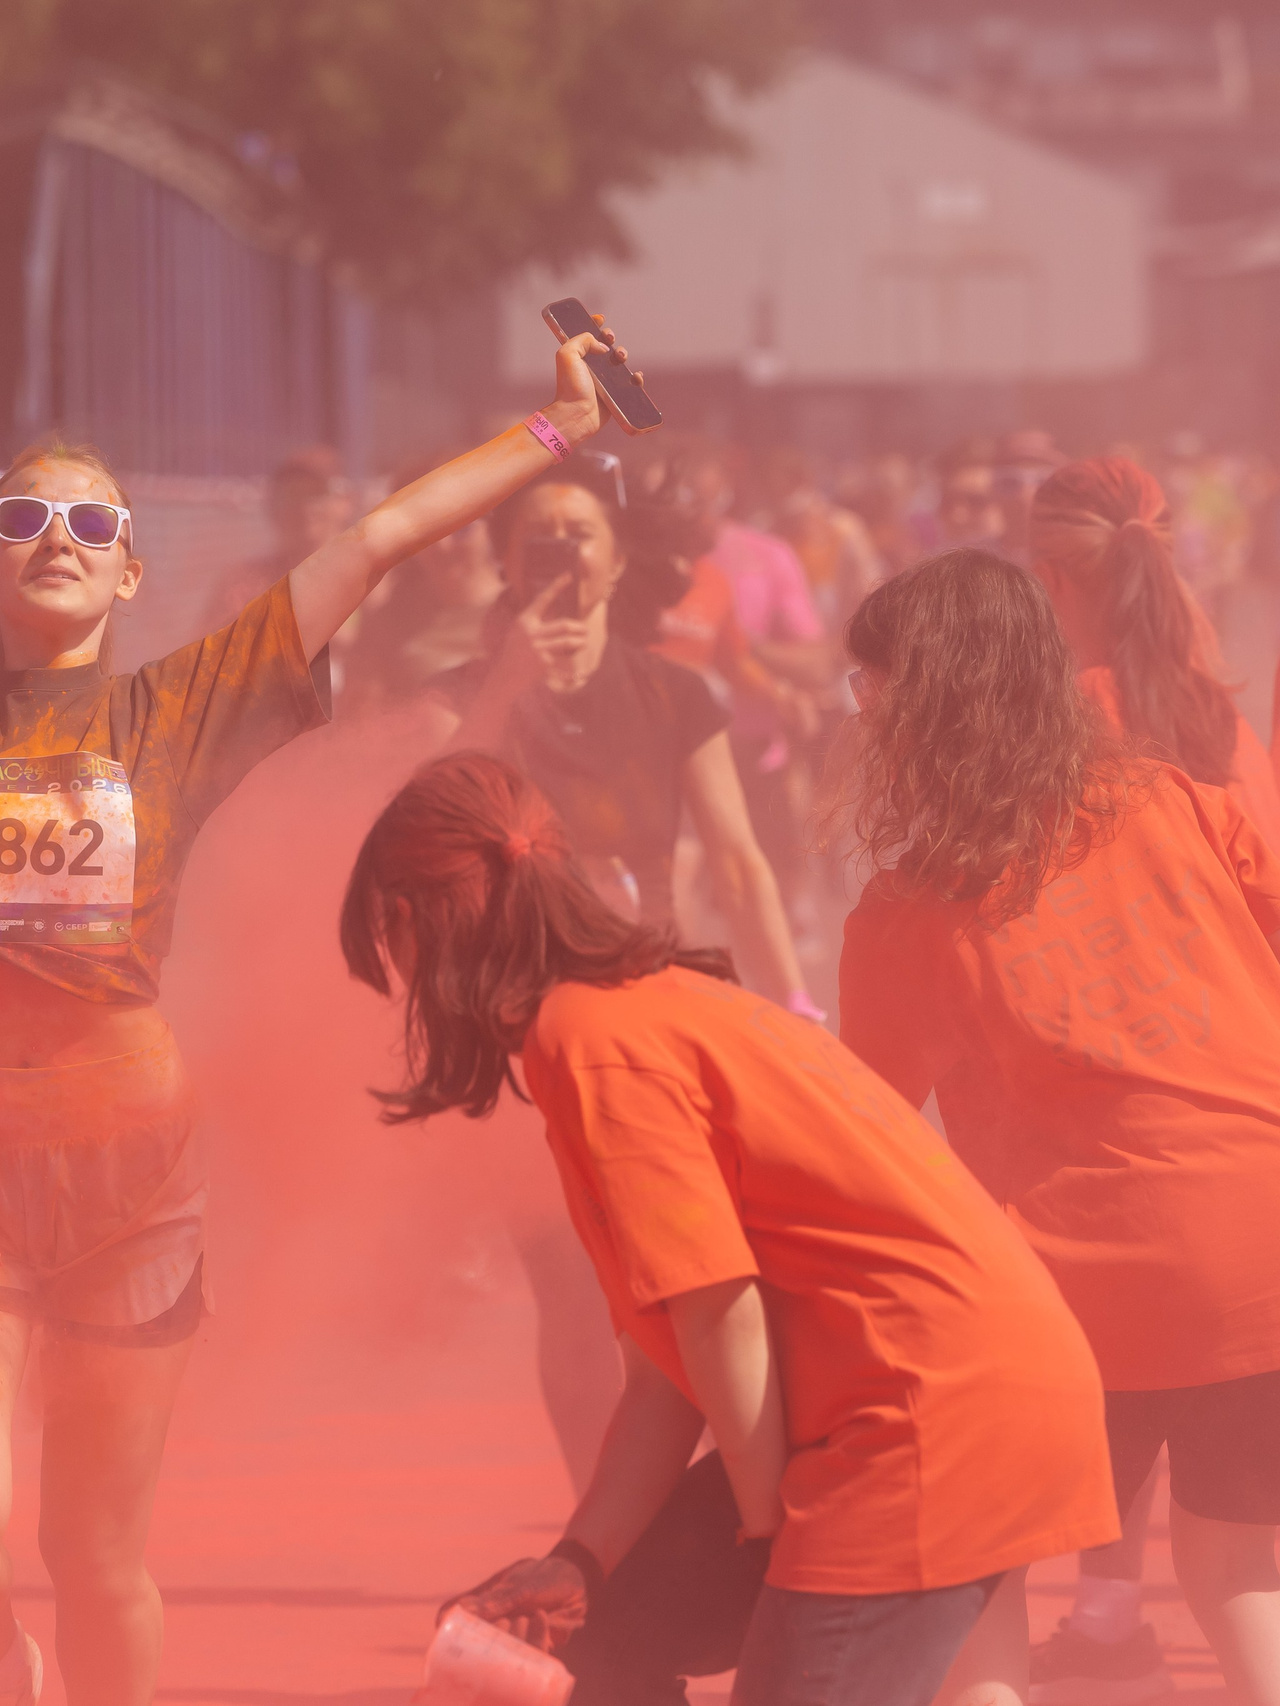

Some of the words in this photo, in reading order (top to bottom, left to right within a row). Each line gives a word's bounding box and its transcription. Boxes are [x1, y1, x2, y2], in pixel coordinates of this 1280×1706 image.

[47, 778, 128, 795] 2026
[66, 923, 88, 931] СБЕР
[1002, 868, 1209, 997] mark
[1024, 926, 1203, 1054] your
